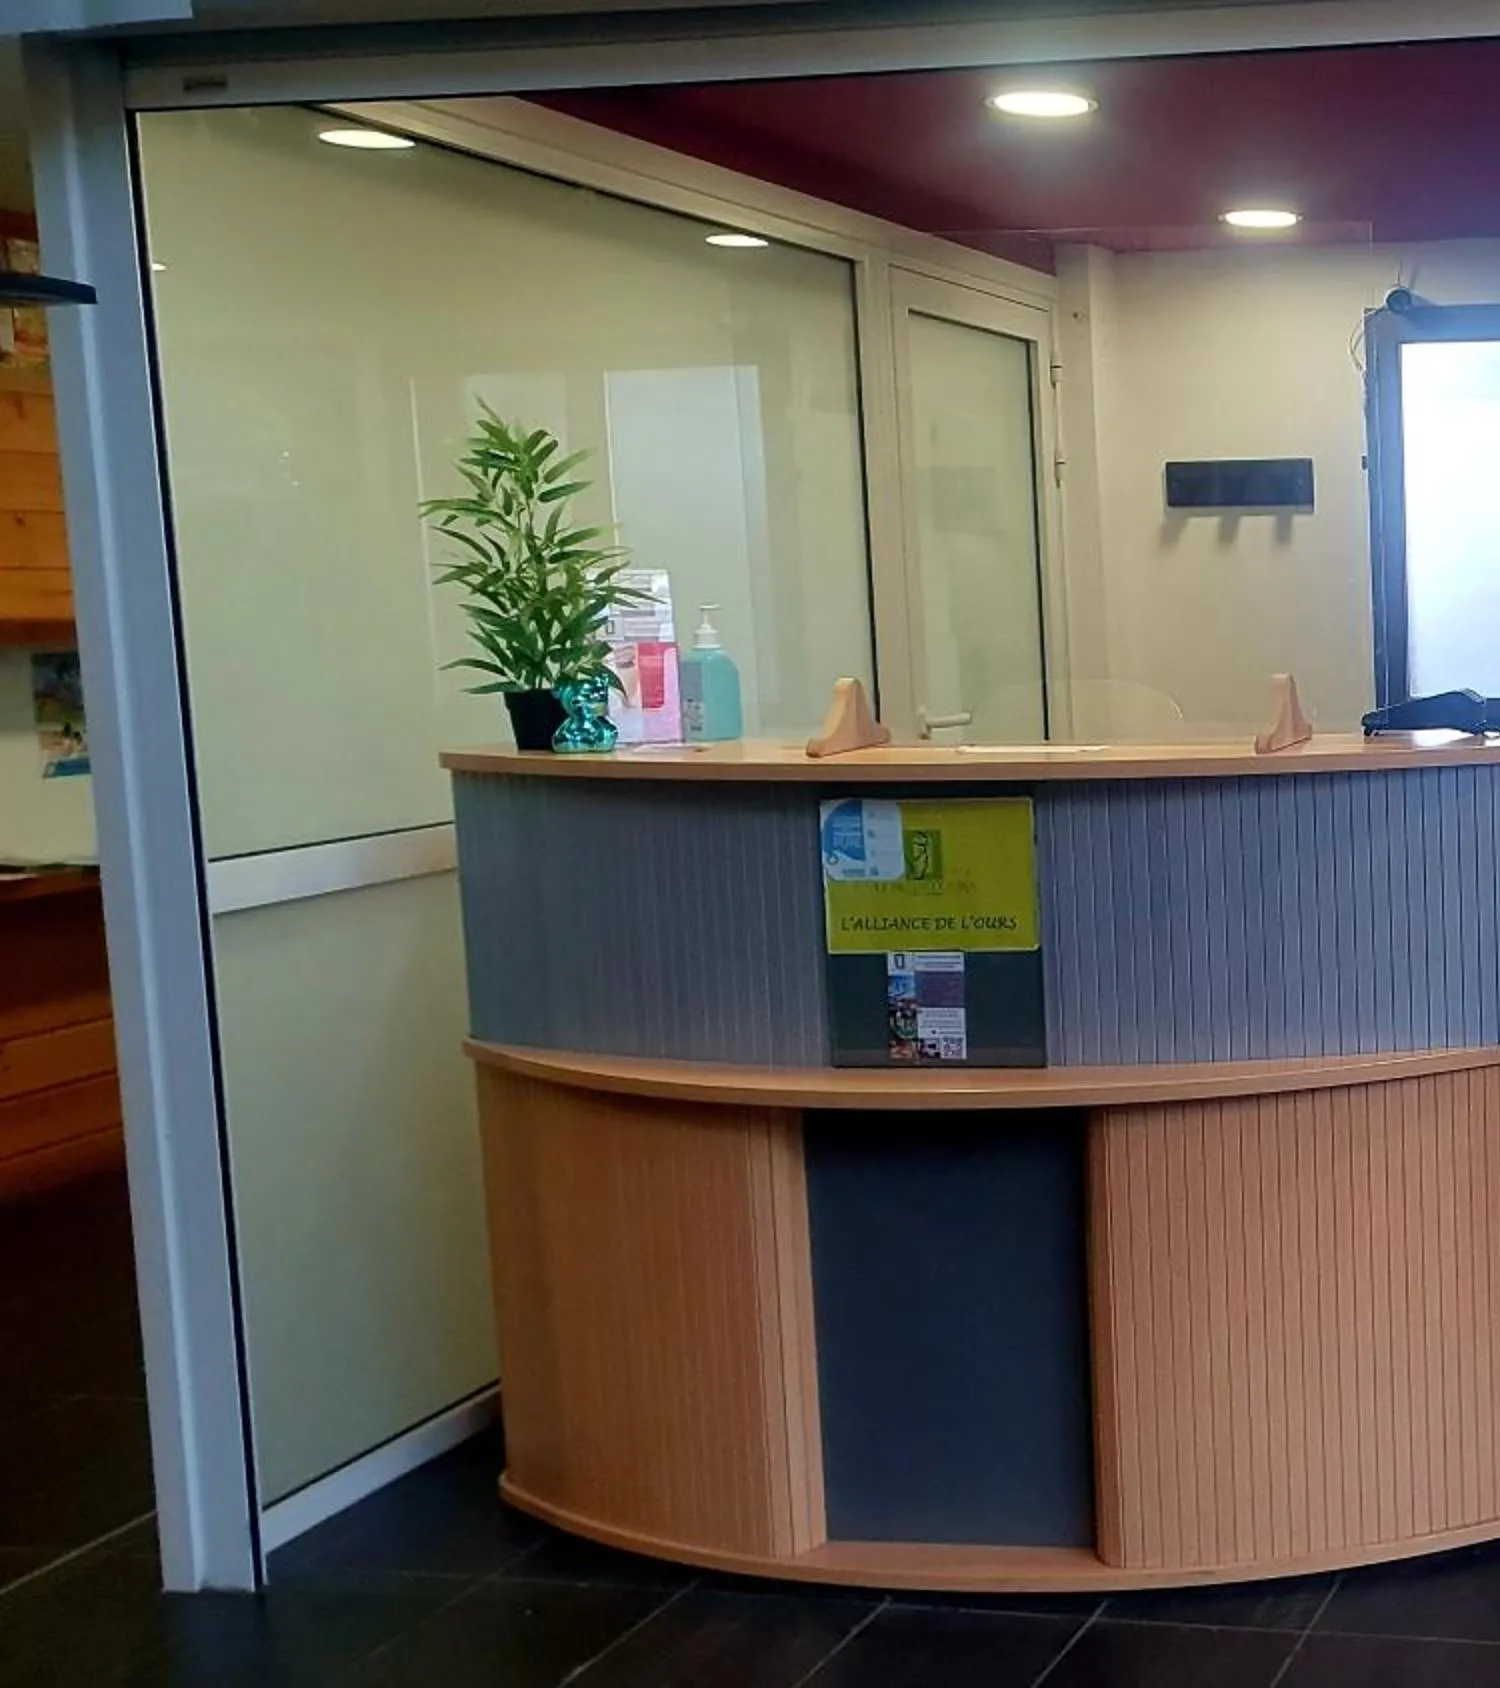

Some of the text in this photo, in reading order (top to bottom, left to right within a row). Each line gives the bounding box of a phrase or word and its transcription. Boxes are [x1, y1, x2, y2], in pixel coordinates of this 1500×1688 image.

[840, 915, 1018, 931] L'ALLIANCE DE L'OURS
